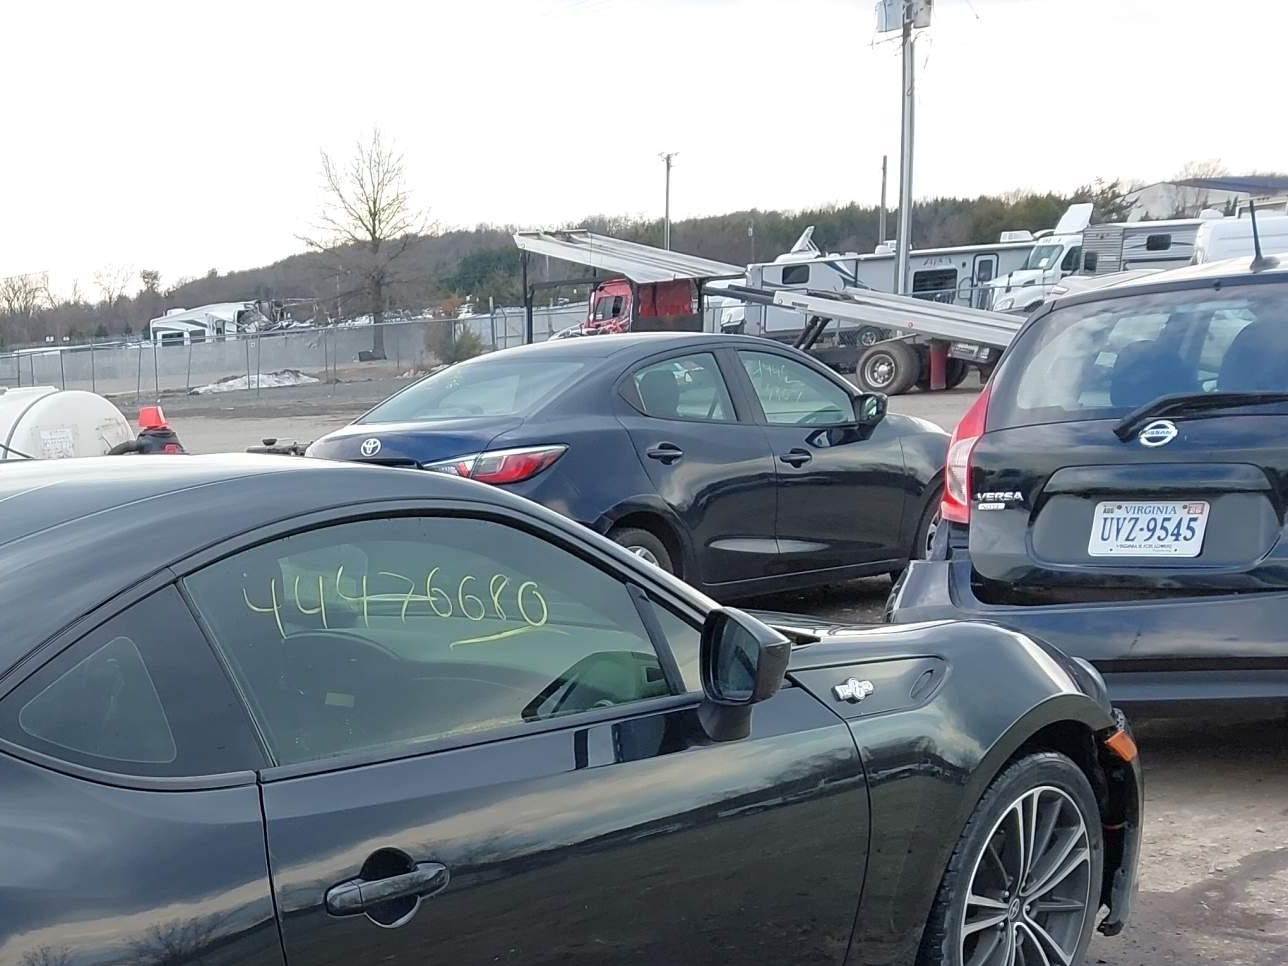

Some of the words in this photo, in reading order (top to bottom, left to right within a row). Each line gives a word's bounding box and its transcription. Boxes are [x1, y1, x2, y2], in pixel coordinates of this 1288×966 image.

[977, 491, 1024, 501] VERSA
[1124, 505, 1177, 515] VIRGINIA
[1100, 517, 1199, 542] UVZ-9545
[242, 564, 549, 640] 44476680
